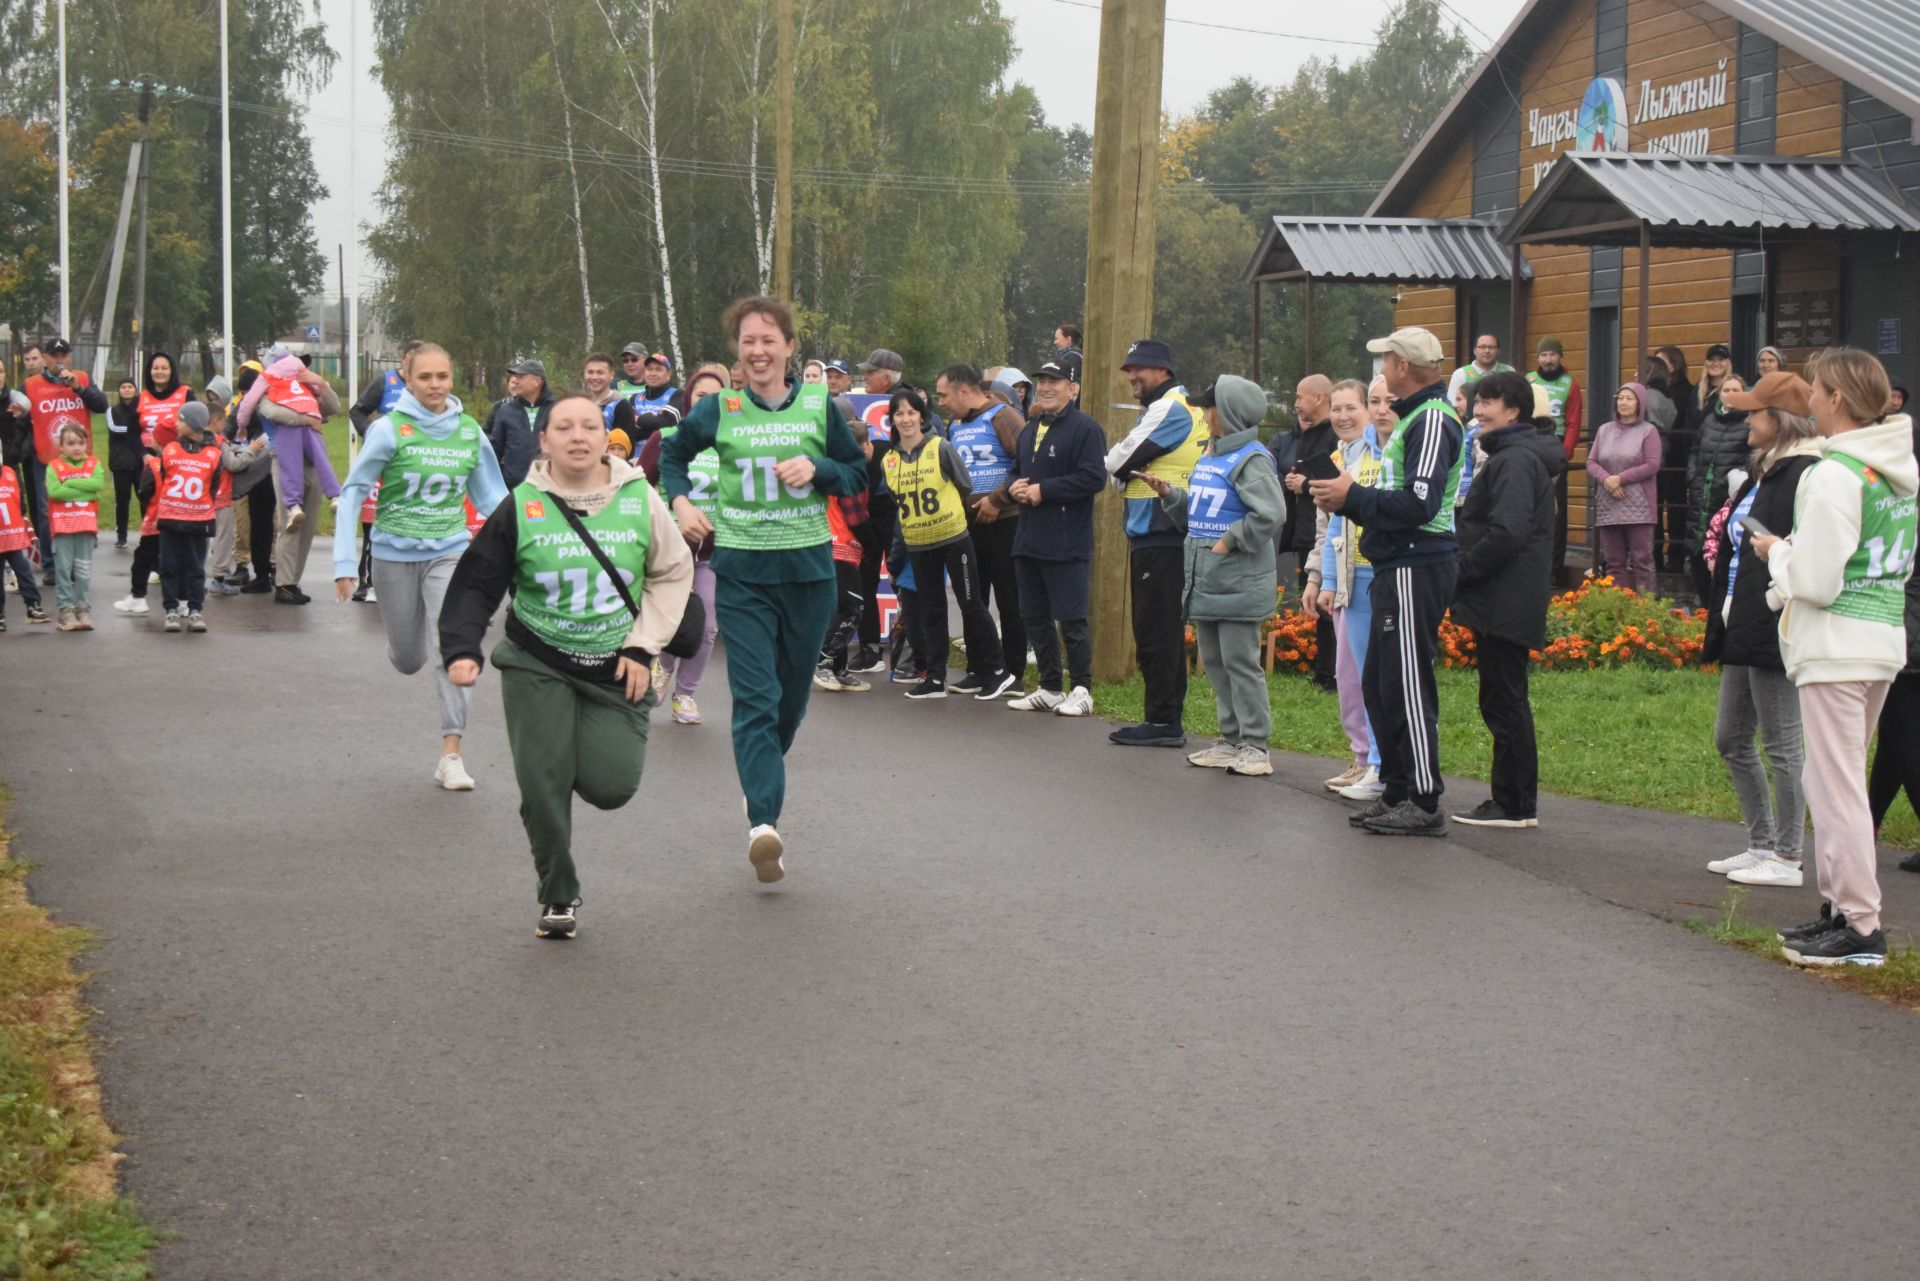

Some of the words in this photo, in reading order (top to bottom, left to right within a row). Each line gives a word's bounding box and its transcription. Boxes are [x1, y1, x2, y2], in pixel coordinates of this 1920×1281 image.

[1634, 57, 1727, 124] Лыжный
[1529, 108, 1578, 152] Чаңгы
[1648, 127, 1709, 155] центр
[39, 398, 84, 413] СУДЬЯ
[732, 422, 817, 437] ТУКАЕВСКИЙ
[751, 435, 800, 447] РАЙОН
[405, 446, 472, 459] ТУКАЕВСКИЙ
[422, 457, 460, 468] РАЙОН
[166, 474, 203, 500] 20
[403, 472, 468, 503] 101
[1189, 485, 1227, 517] 77
[557, 546, 615, 558] РАЙН
[534, 567, 635, 615] 118
[580, 658, 605, 667] HAPPY
